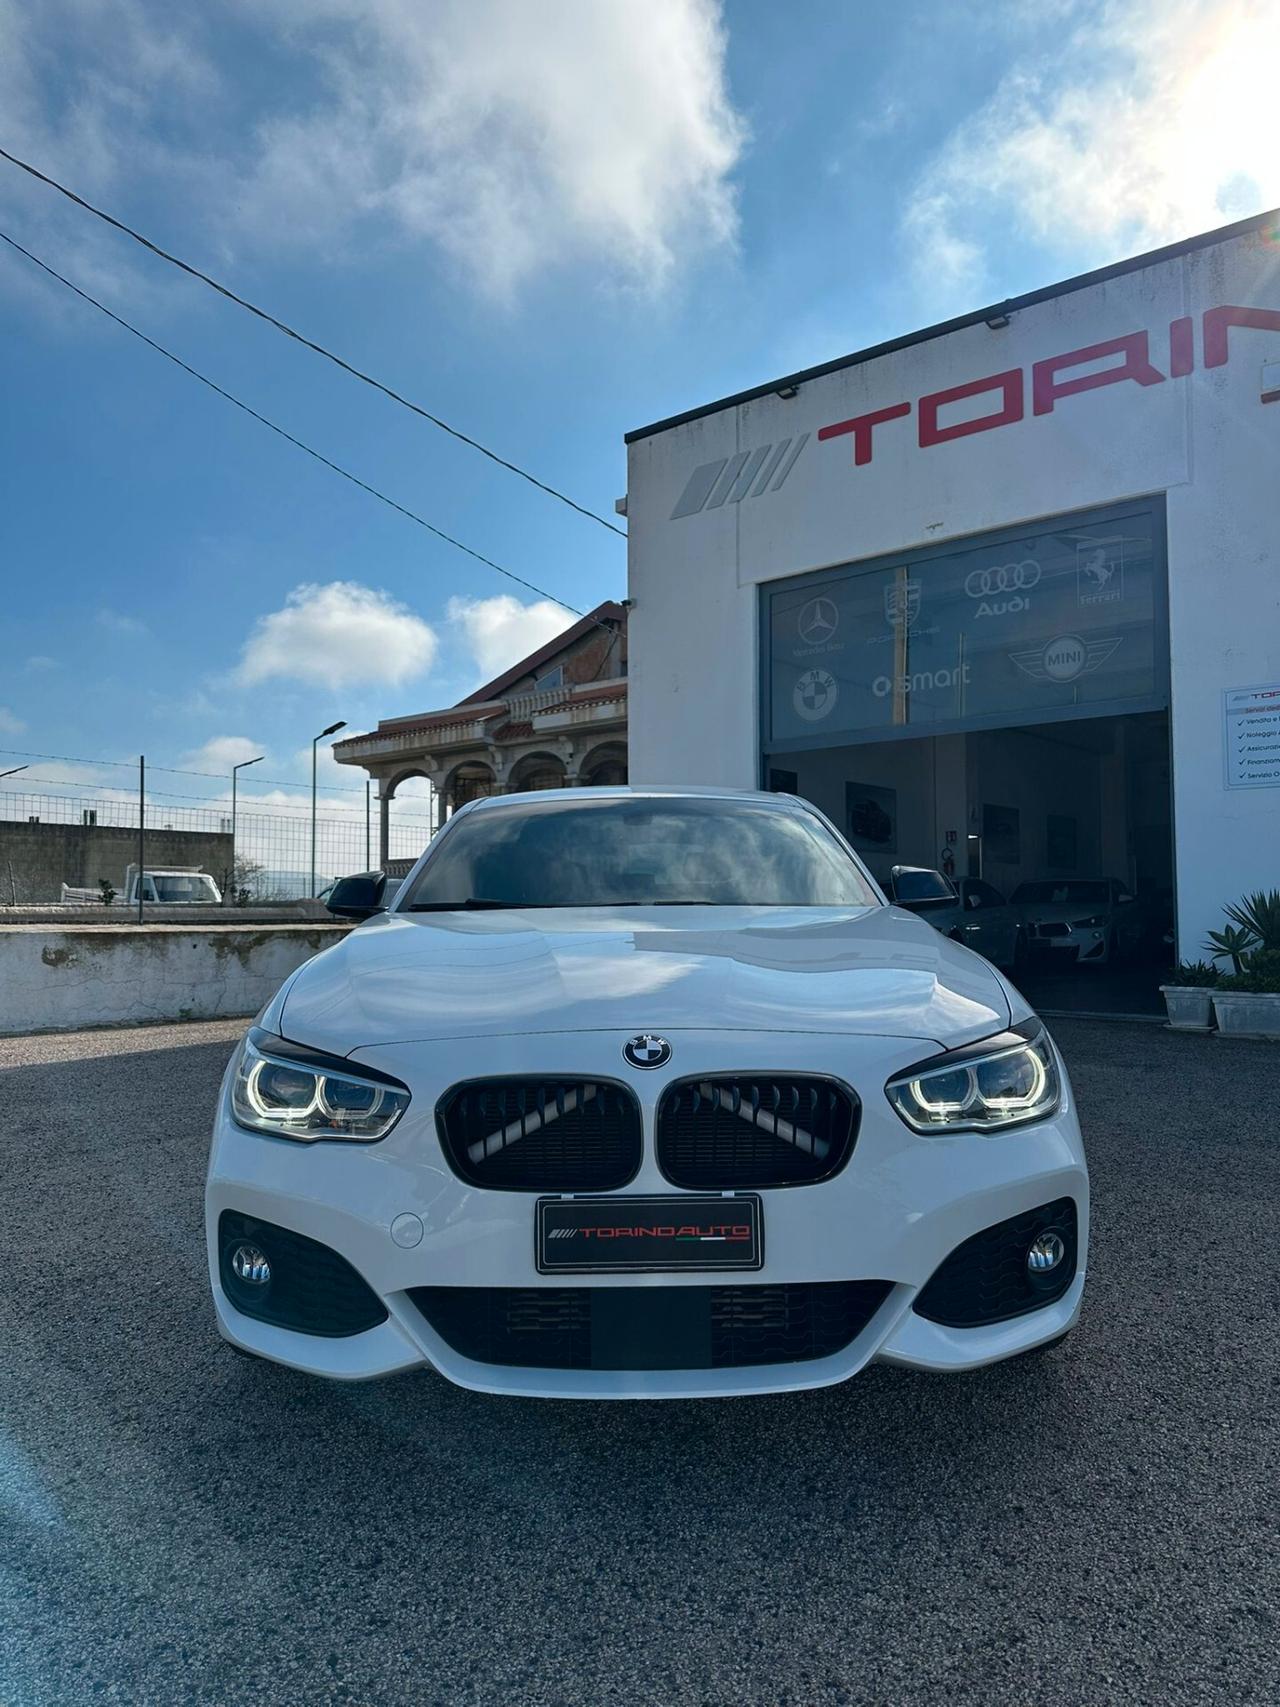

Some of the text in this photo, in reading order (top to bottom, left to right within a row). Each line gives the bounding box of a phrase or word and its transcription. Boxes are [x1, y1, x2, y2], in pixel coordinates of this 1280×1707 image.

[974, 596, 1030, 619] Audi
[1048, 651, 1080, 666] MINI
[898, 664, 970, 691] smart
[579, 1226, 750, 1237] TORINOAUTO
